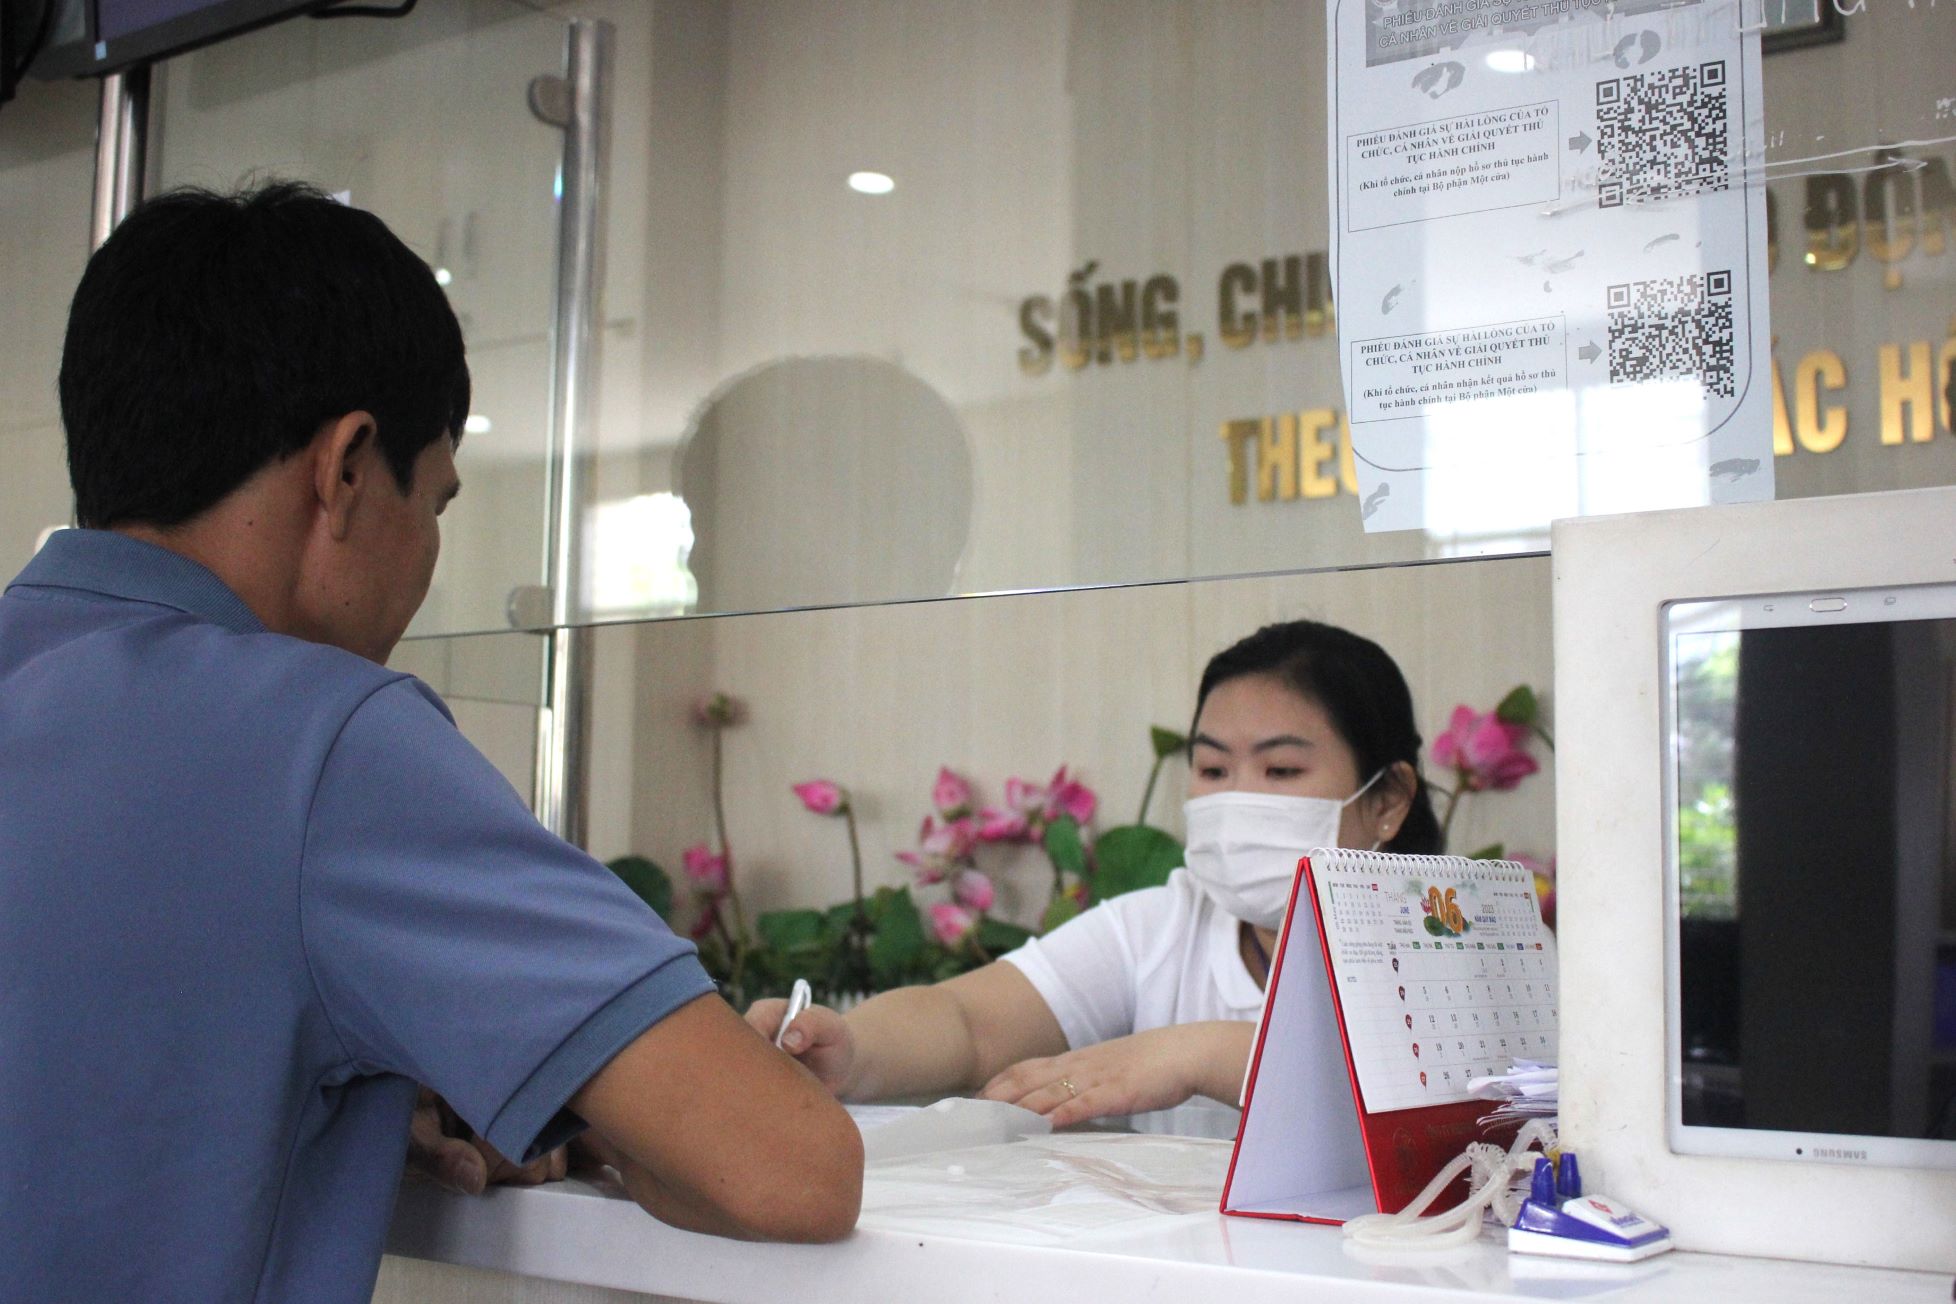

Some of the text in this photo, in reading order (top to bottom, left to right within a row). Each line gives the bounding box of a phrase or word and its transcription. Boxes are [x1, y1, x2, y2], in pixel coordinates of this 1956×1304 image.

[1384, 9, 1422, 29] PHIẾU
[1400, 25, 1437, 44] NHÂN
[1491, 6, 1538, 25] QUYẾT
[1357, 134, 1387, 147] PHIẾU
[1389, 129, 1417, 142] ĐÁNH
[1419, 124, 1437, 136] GIÁ
[1478, 114, 1507, 127] LÒNG
[1394, 142, 1408, 154] CÁ
[1410, 137, 1438, 150] NHÂN
[1457, 130, 1480, 142] GIẢI
[1483, 124, 1520, 139] QUYẾT
[1523, 119, 1544, 132] THỦ
[1406, 142, 1495, 164] TỤC HÀNH CHÍNH
[1414, 172, 1423, 181] cá
[1426, 168, 1447, 178] nhân
[1511, 158, 1525, 167] tục
[1527, 152, 1549, 163] hành
[1393, 186, 1416, 197] chính
[1419, 184, 1430, 194] tại
[1432, 182, 1444, 191] Bộ
[1446, 179, 1468, 190] phận
[1470, 175, 1488, 185] Một
[1361, 342, 1391, 354] PHIẾU
[1393, 338, 1421, 350] ĐÁNH
[1425, 334, 1443, 346] GIÁ
[1484, 327, 1512, 339] LÒNG
[1399, 351, 1413, 362] CÁ
[1416, 348, 1444, 360] NHÂN
[1464, 343, 1487, 354] GIẢI
[1490, 338, 1525, 352] QUYẾT
[1528, 334, 1550, 347] THỦ
[1412, 355, 1501, 375] TỤC HÀNH CHÍNH
[1420, 383, 1429, 391] cá
[1432, 380, 1453, 390] nhân
[1456, 378, 1478, 389] nhận
[1481, 374, 1494, 385] kết
[1379, 401, 1392, 410] tục
[1395, 398, 1415, 408] hành
[1418, 395, 1442, 405] chính
[1445, 393, 1456, 404] tại
[1498, 386, 1515, 397] Một
[1813, 1148, 1867, 1160] SAMSUNG
